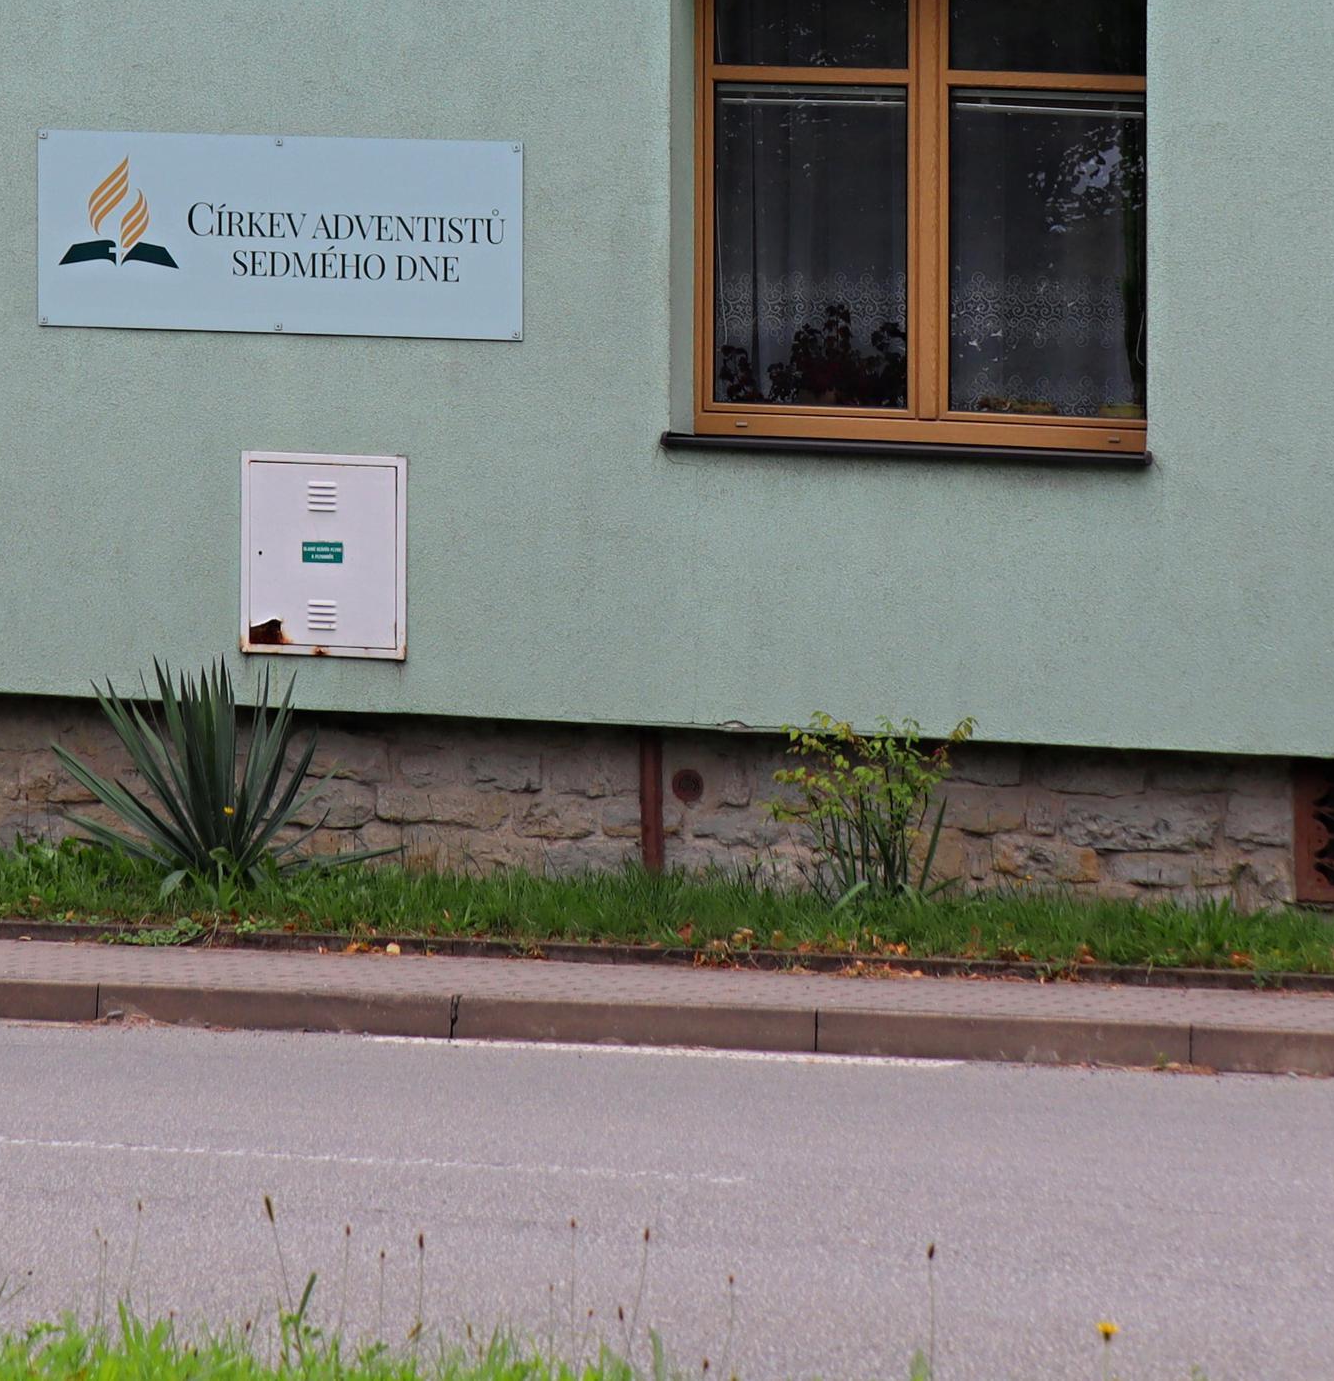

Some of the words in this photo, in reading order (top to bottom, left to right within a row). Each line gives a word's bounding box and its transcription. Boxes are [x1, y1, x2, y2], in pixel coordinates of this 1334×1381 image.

[187, 201, 307, 239] CÍRKEV
[312, 209, 507, 245] ADVENTISTŮ
[232, 245, 386, 281] SEDMÉHO
[395, 254, 460, 283] DNE
